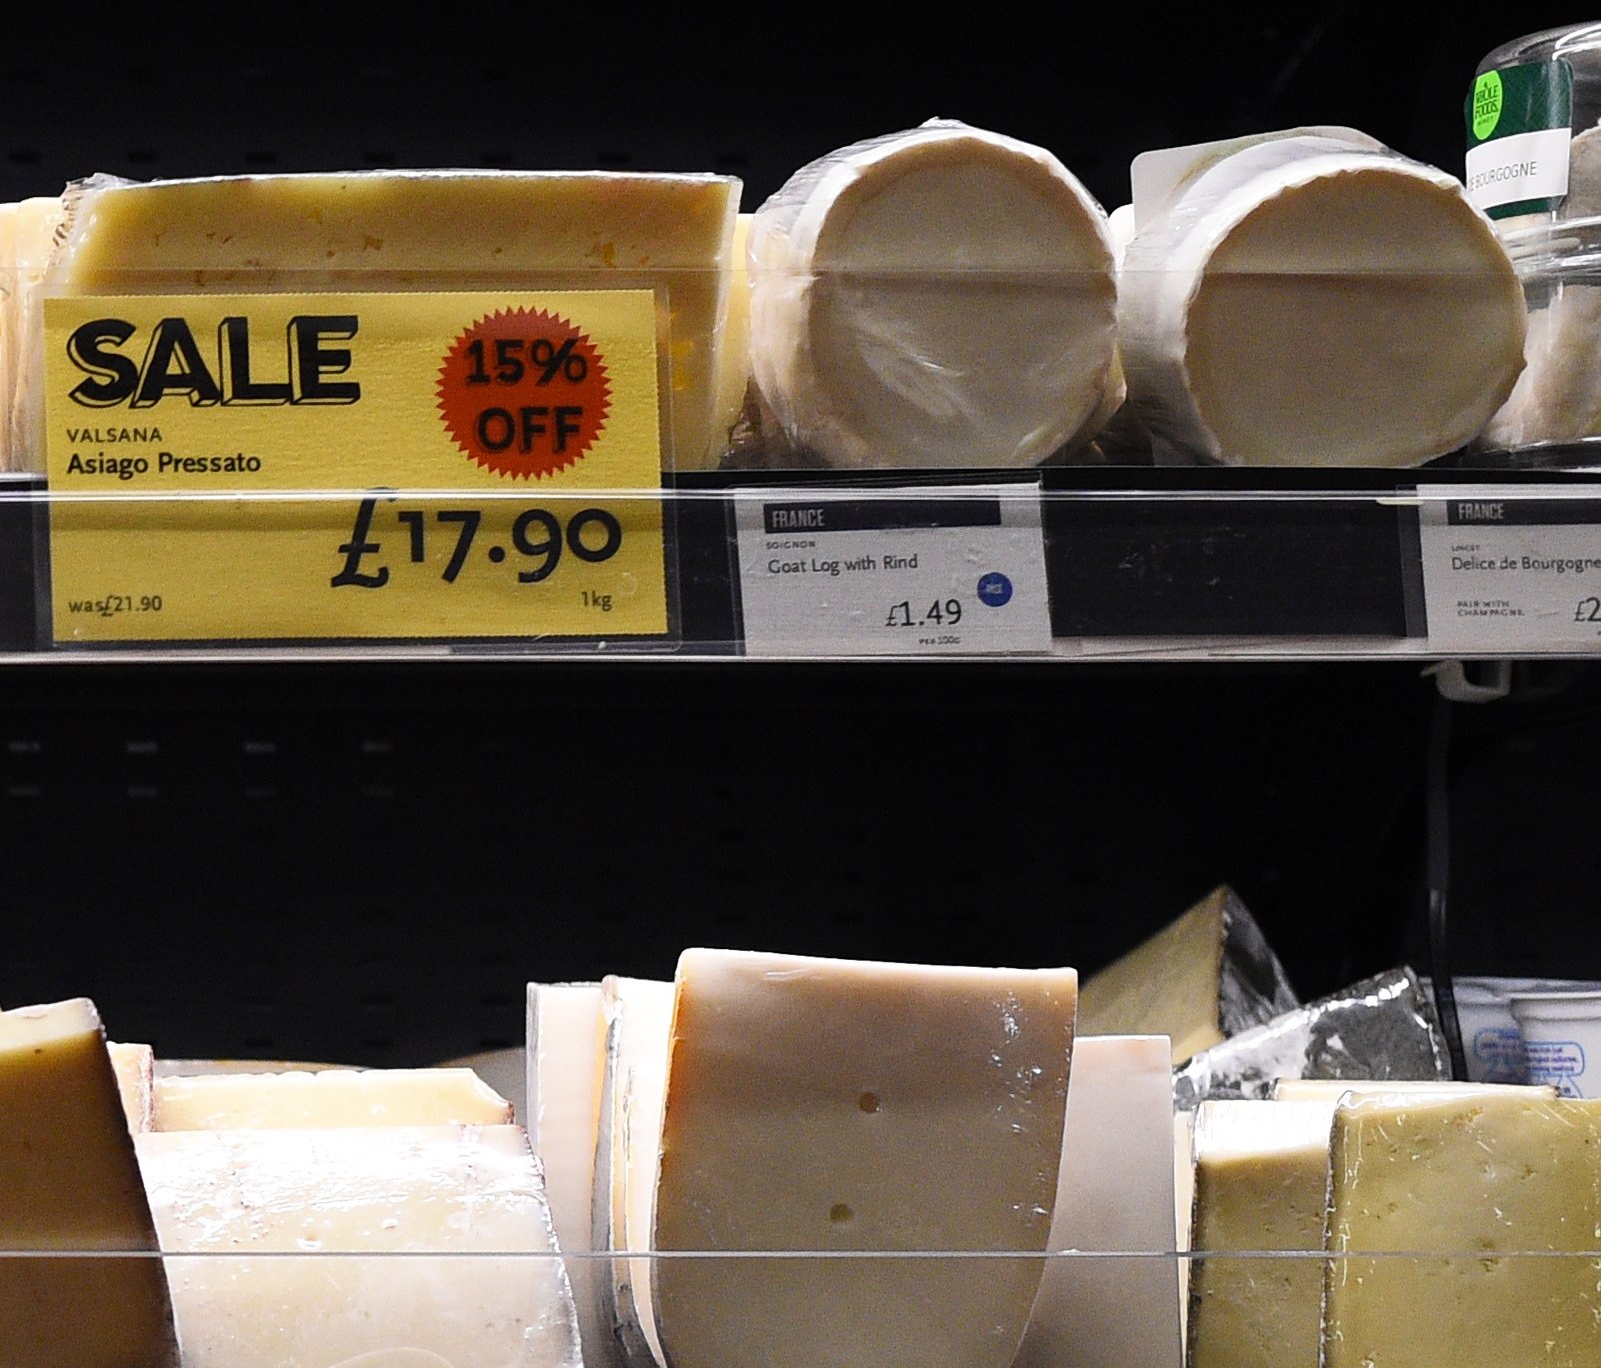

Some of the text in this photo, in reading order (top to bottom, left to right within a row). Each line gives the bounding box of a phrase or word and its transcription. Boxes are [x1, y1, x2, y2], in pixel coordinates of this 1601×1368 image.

[1475, 161, 1537, 187] BOURGOGNE
[66, 315, 360, 409] SALE
[465, 338, 589, 385] 15%
[66, 427, 163, 443] VALSANA
[477, 405, 584, 454] OFF
[67, 452, 262, 481] Asiago Pressato
[329, 487, 623, 589] £17.90
[767, 554, 919, 576] Goat Log with Rind
[885, 599, 963, 628] £1.49
